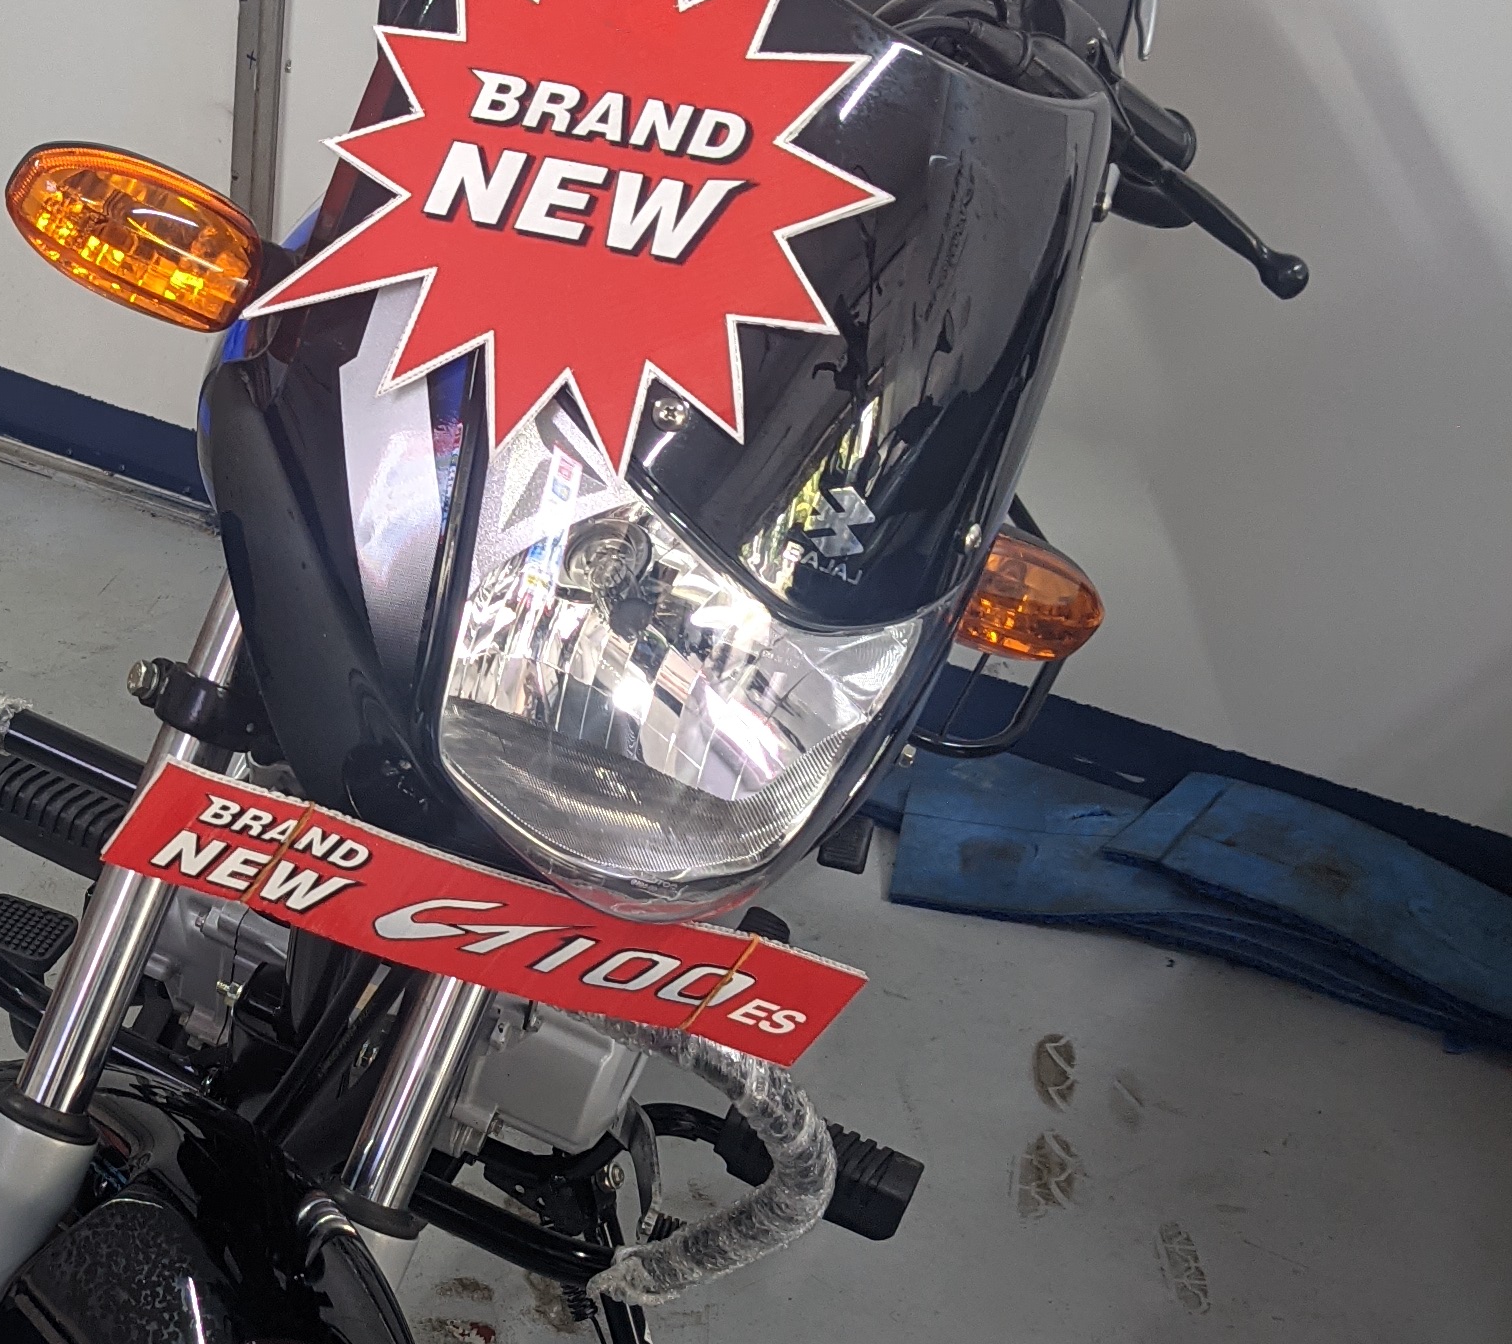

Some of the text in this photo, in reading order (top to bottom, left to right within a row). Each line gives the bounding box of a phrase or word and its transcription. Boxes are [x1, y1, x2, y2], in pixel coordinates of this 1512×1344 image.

[470, 68, 751, 163] BRAND
[423, 140, 756, 264] NEW
[782, 541, 863, 585] BAJAJ
[151, 830, 364, 913] NEW
[197, 793, 372, 869] BRAND
[373, 898, 808, 1036] CT100 ES
